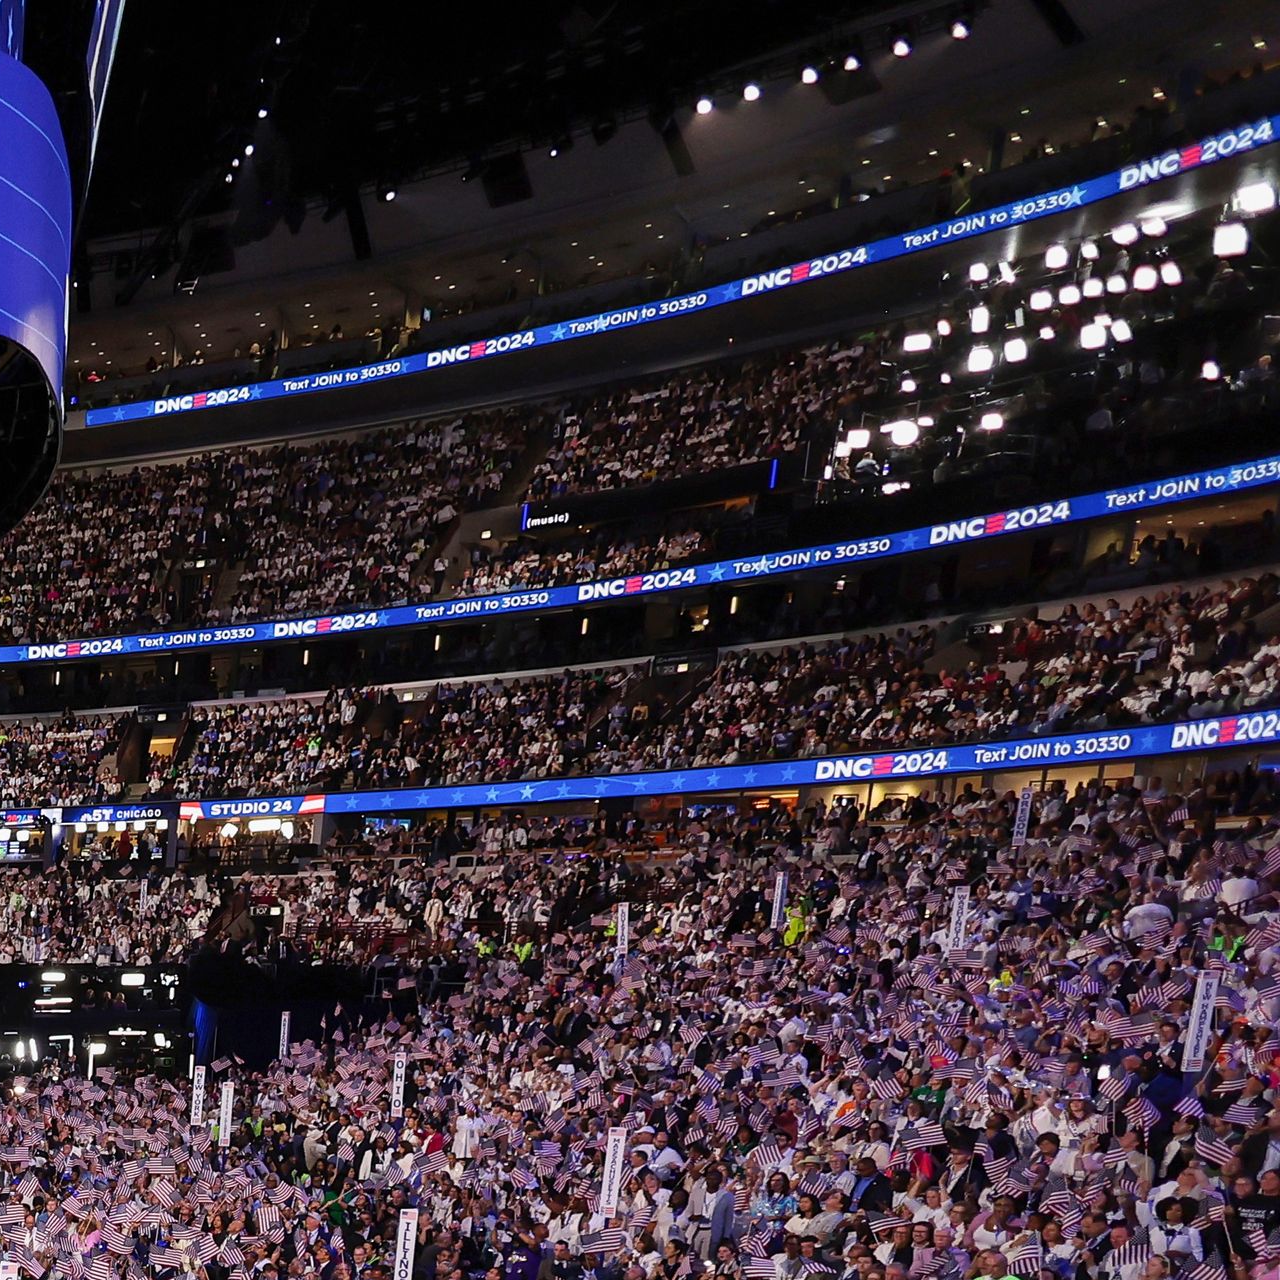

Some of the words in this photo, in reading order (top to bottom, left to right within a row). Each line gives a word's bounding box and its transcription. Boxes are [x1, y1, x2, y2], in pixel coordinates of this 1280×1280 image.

[1119, 153, 1179, 190] DNC
[1200, 121, 1272, 161] 2024
[741, 272, 792, 296] DNC
[808, 247, 866, 278] 2024
[427, 345, 470, 368] DNC
[485, 331, 535, 354] 2024
[283, 378, 309, 392] Text
[311, 372, 342, 388] JOIN
[345, 369, 358, 382] to
[361, 362, 400, 380] 30330
[154, 394, 192, 414] DNC
[207, 386, 251, 405] 2024
[1106, 489, 1146, 508] Text
[1149, 479, 1199, 500] JOIN
[1204, 475, 1225, 489] to
[929, 518, 986, 545] DNC
[1004, 501, 1070, 530] 2024
[578, 579, 625, 602] DNC
[642, 568, 696, 590] 2024
[274, 620, 316, 638] DNC
[330, 612, 378, 631] 2024
[28, 643, 67, 660] DNC
[80, 639, 123, 656] 2024
[974, 747, 1008, 764] Text
[1009, 743, 1050, 760] JOIN
[1054, 739, 1071, 756] to
[1074, 734, 1131, 755] 30330
[1171, 720, 1220, 749] DNC
[815, 758, 872, 780] DNC
[892, 751, 947, 774] 2024
[116, 808, 162, 819] CHICAGO
[210, 802, 271, 816] STUDIO
[272, 800, 293, 813] 24
[1015, 793, 1030, 837] OREGON
[195, 1072, 204, 1089] NEW
[393, 1060, 404, 1108] OHIO
[193, 1093, 202, 1118] YORK
[606, 1137, 621, 1206] MASSACHUSETTS
